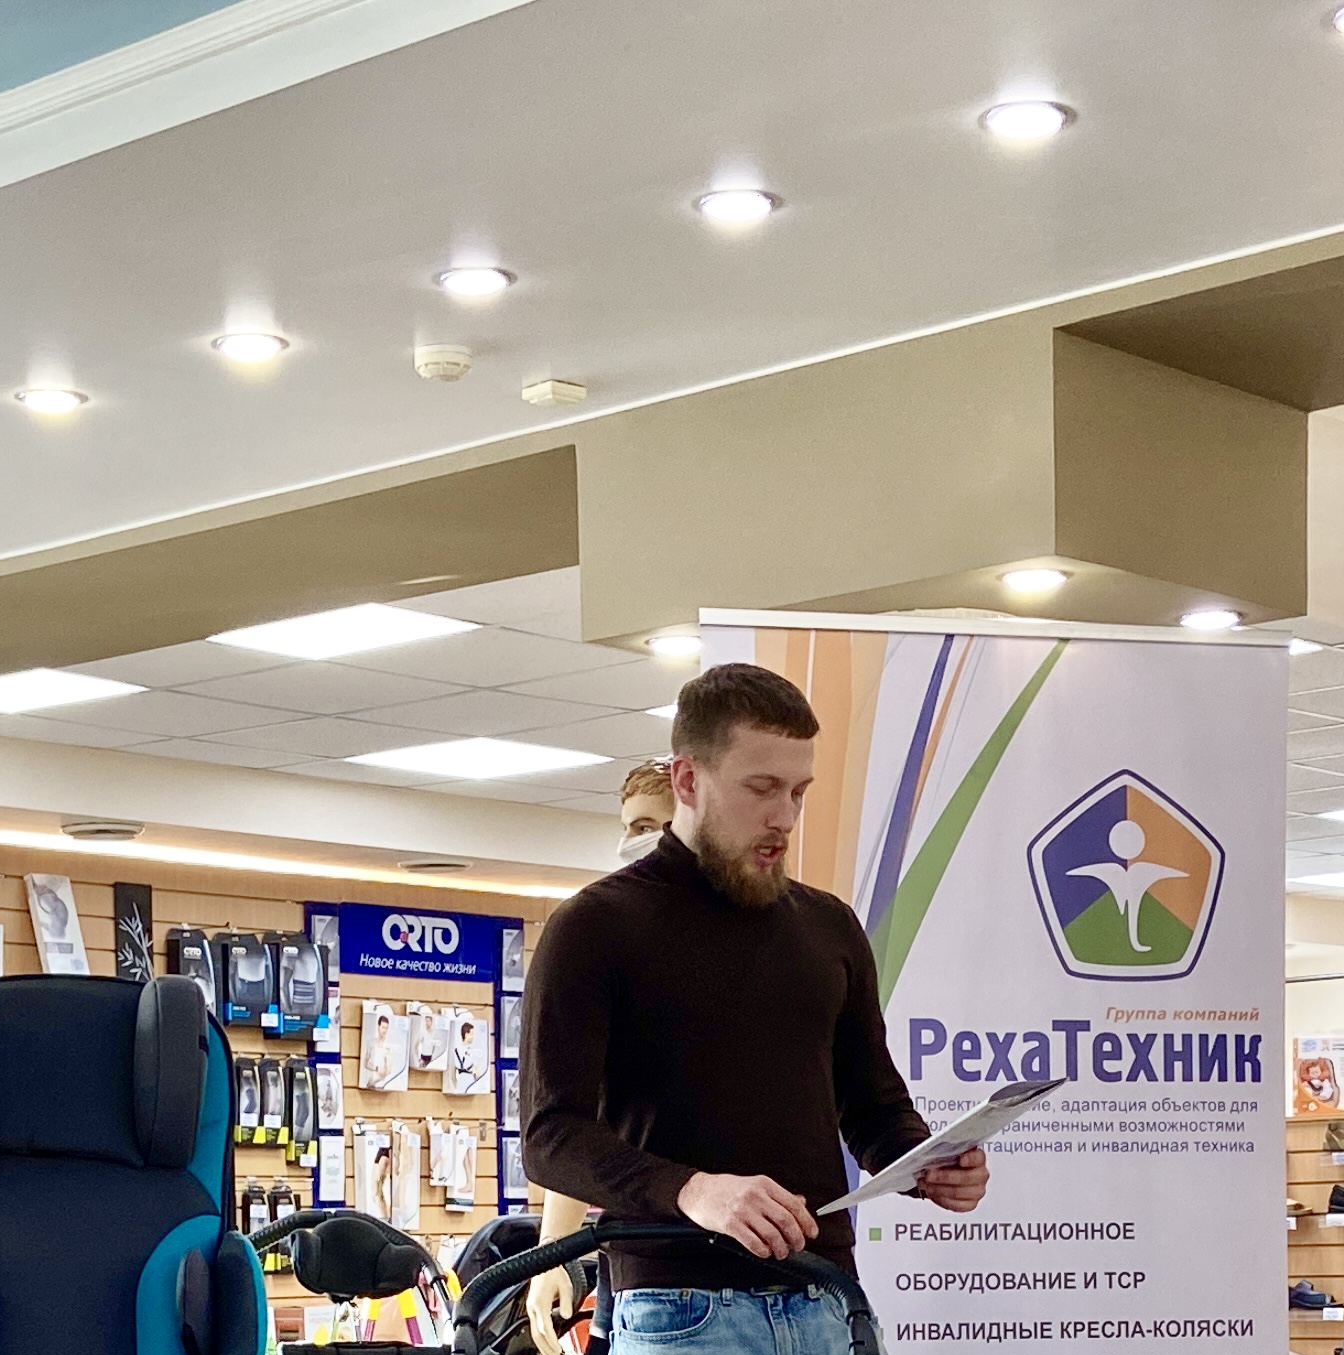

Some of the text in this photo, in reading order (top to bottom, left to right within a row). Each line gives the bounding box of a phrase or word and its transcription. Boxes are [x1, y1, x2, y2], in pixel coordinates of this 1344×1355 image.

[382, 914, 460, 955] ORTO
[359, 953, 476, 975] Новое качество жизни
[1106, 1007, 1260, 1024] Группа компаний
[909, 1018, 1262, 1084] РехаТехник
[1061, 1099, 1147, 1115] адаптация
[1152, 1097, 1226, 1113] объектов
[1230, 1100, 1258, 1115] для
[1119, 1119, 1245, 1134] возможностями
[1076, 1142, 1088, 1153] и
[1092, 1139, 1189, 1154] инвалидная
[1194, 1140, 1255, 1153] техника
[894, 1222, 1136, 1243] РЕАБИЛИТАЦИОННОЕ
[895, 1271, 1146, 1294] ОБОРУДОВАНИЕ И ТСР
[896, 1319, 1255, 1344] ИНВАЛИДНЫЕ КРЕСЛА-КОЛЯСКИ
